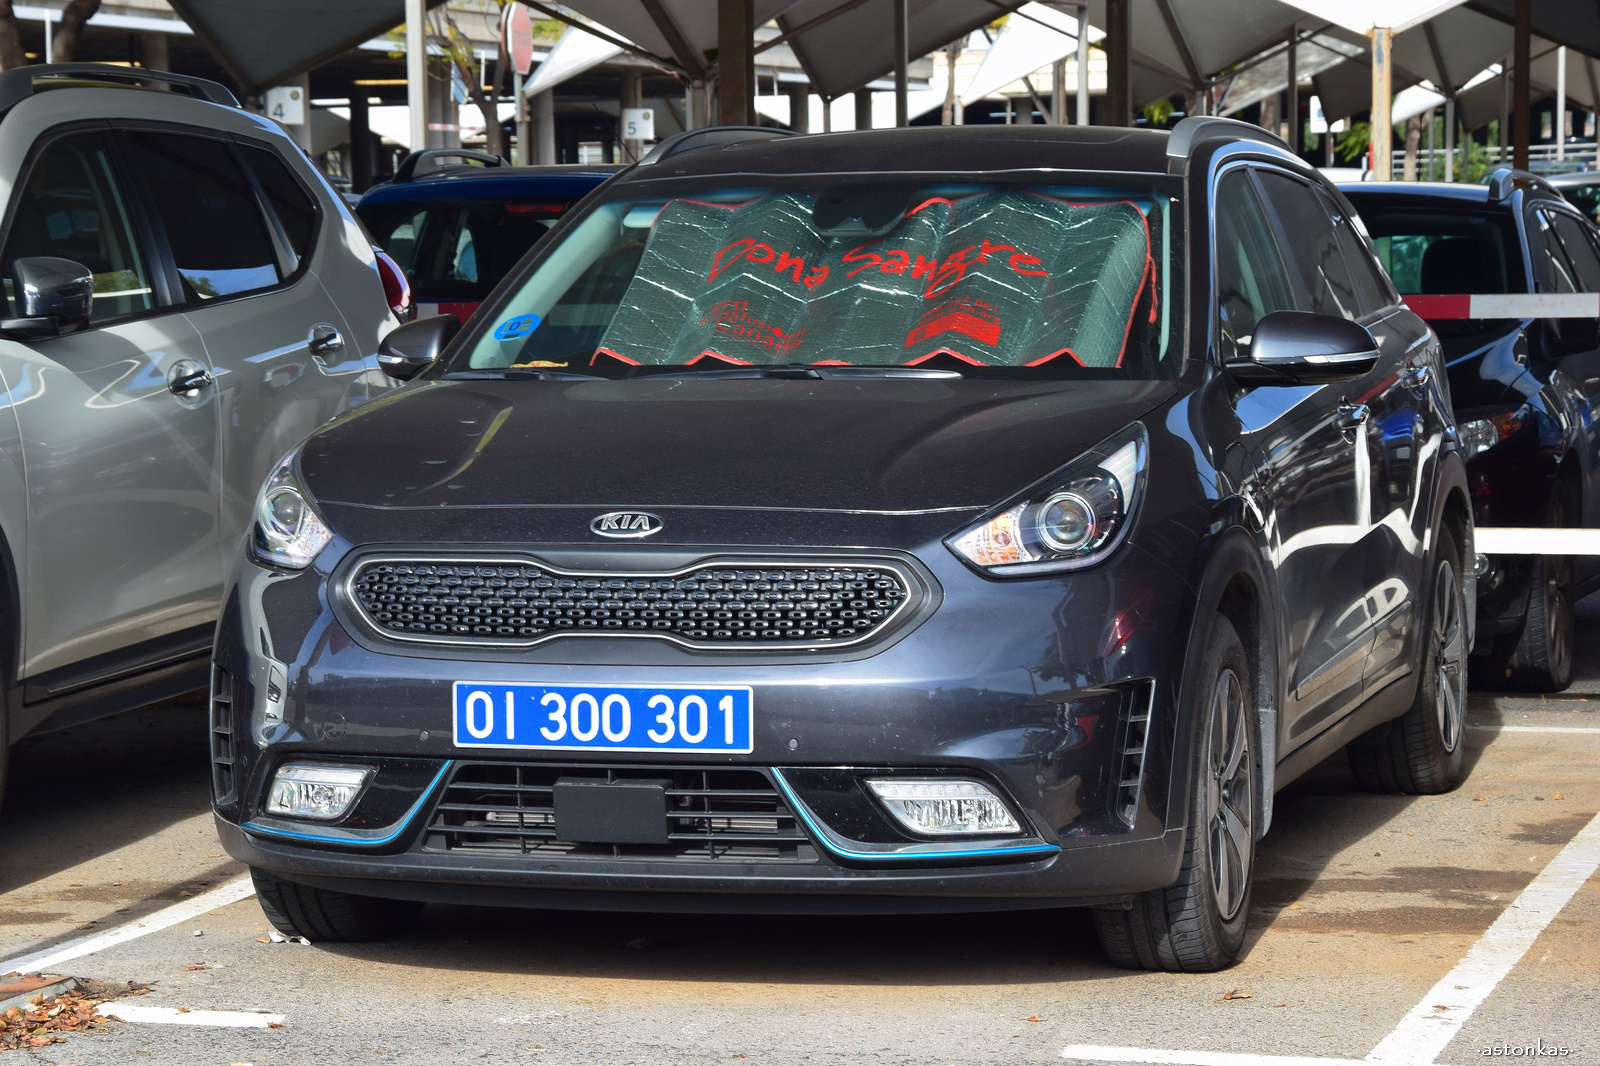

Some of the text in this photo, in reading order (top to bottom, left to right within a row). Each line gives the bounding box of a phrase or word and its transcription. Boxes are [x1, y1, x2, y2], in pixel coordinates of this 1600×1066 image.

[273, 102, 284, 119] 4
[628, 121, 636, 135] 5
[706, 238, 1048, 299] Dona Sangre
[600, 514, 650, 530] KIA
[540, 692, 631, 742] 300
[647, 694, 734, 745] 301
